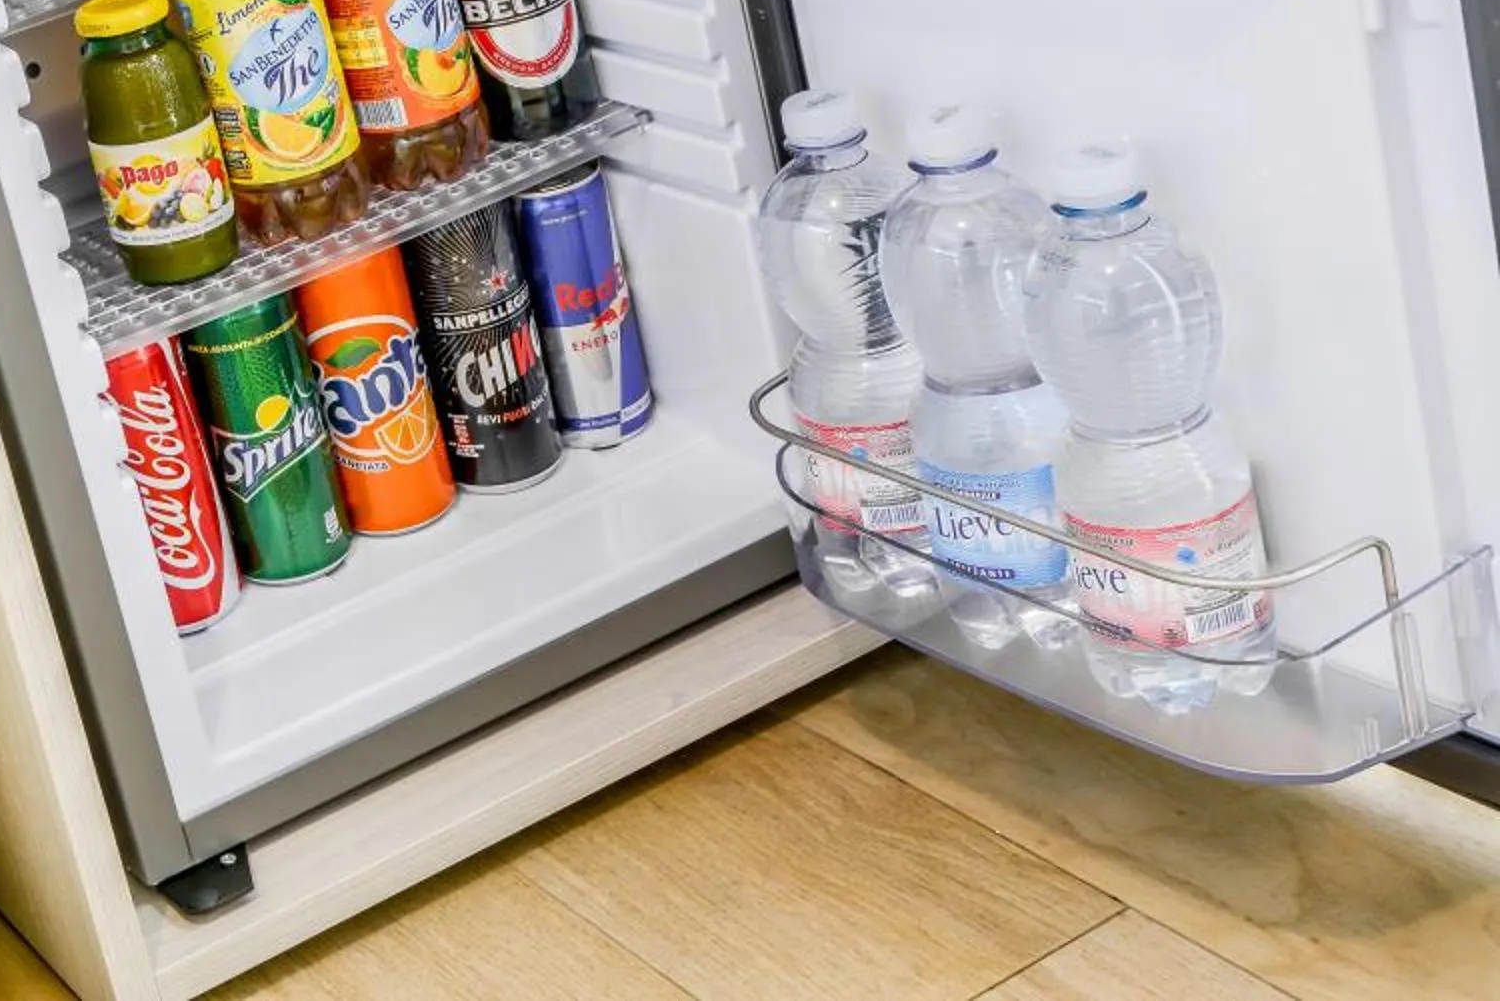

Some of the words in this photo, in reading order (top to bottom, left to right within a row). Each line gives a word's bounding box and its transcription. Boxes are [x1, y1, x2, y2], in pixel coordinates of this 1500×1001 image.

[555, 268, 615, 312] Red
[223, 404, 321, 489] Sprite
[934, 506, 1014, 540] Lieve
[1073, 557, 1127, 594] ieve
